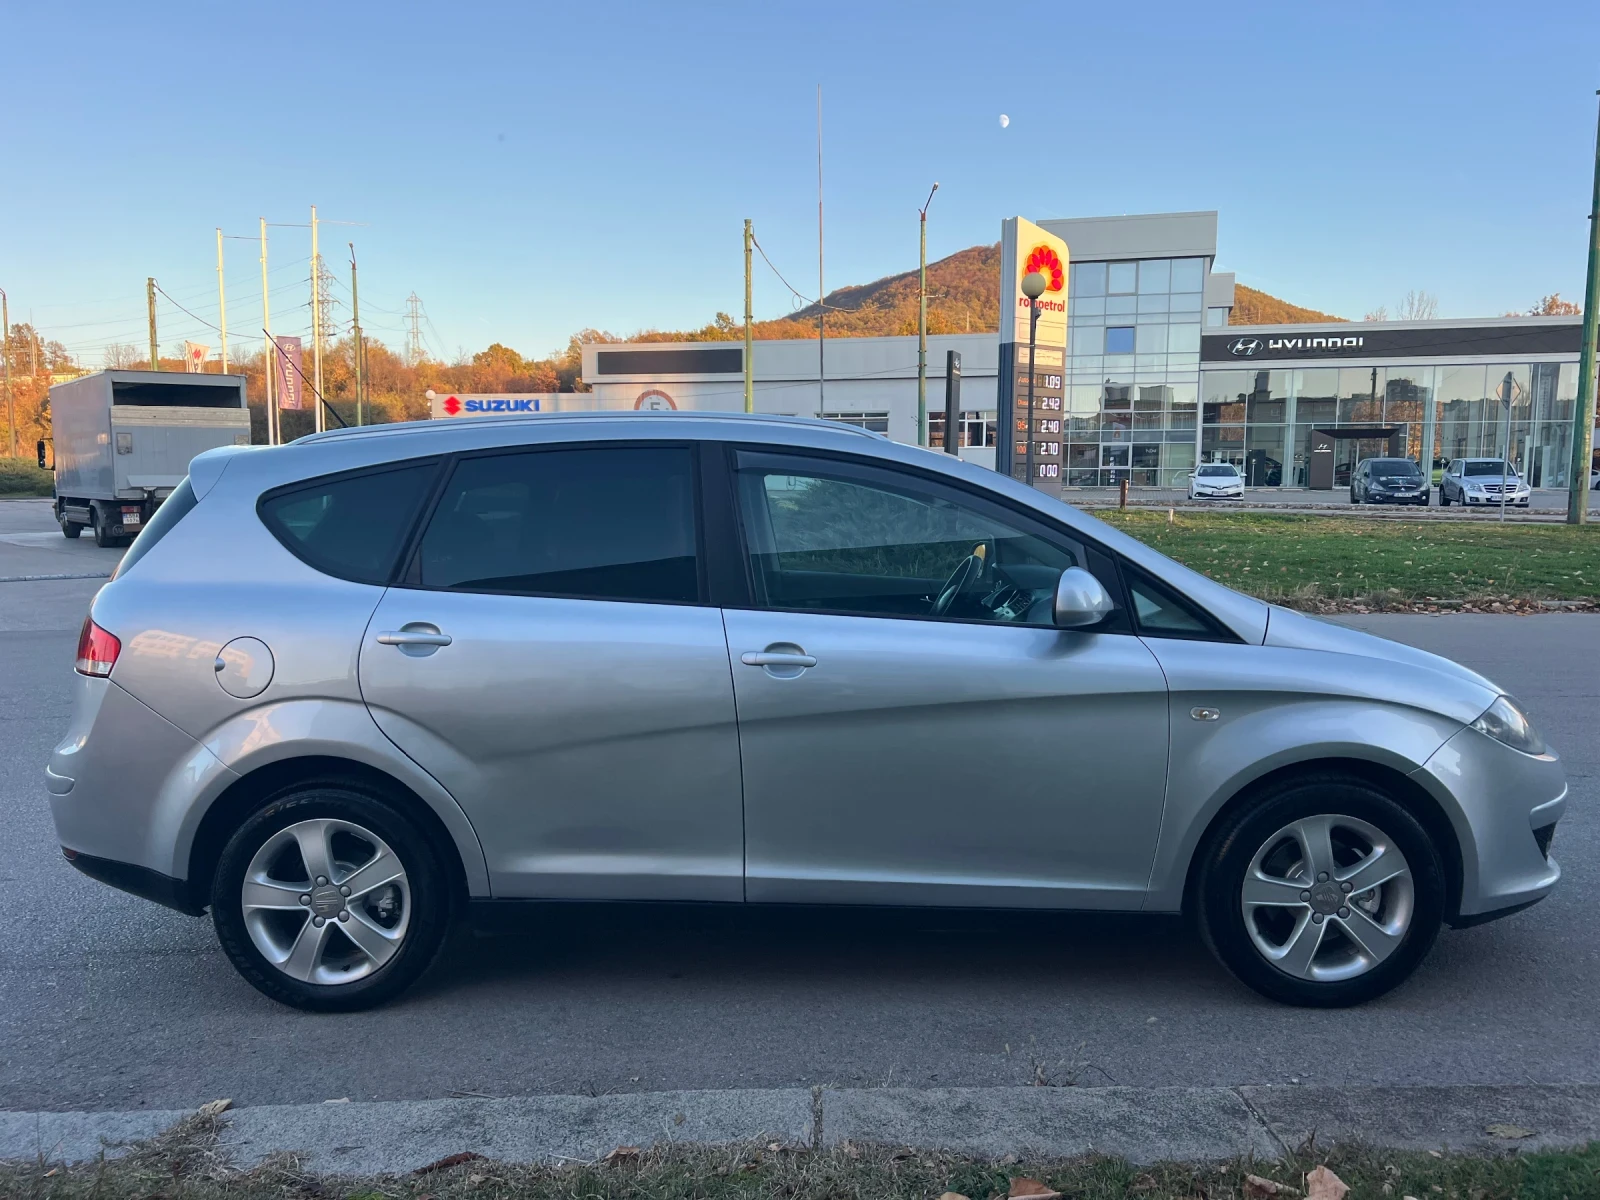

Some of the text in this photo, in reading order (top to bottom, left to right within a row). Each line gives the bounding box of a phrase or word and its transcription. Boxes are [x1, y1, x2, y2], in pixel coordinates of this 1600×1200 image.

[1045, 375, 1061, 389] 1.09
[464, 399, 540, 412] SUZUKI
[1041, 397, 1060, 410] 2.42
[1041, 420, 1059, 433] 2.40
